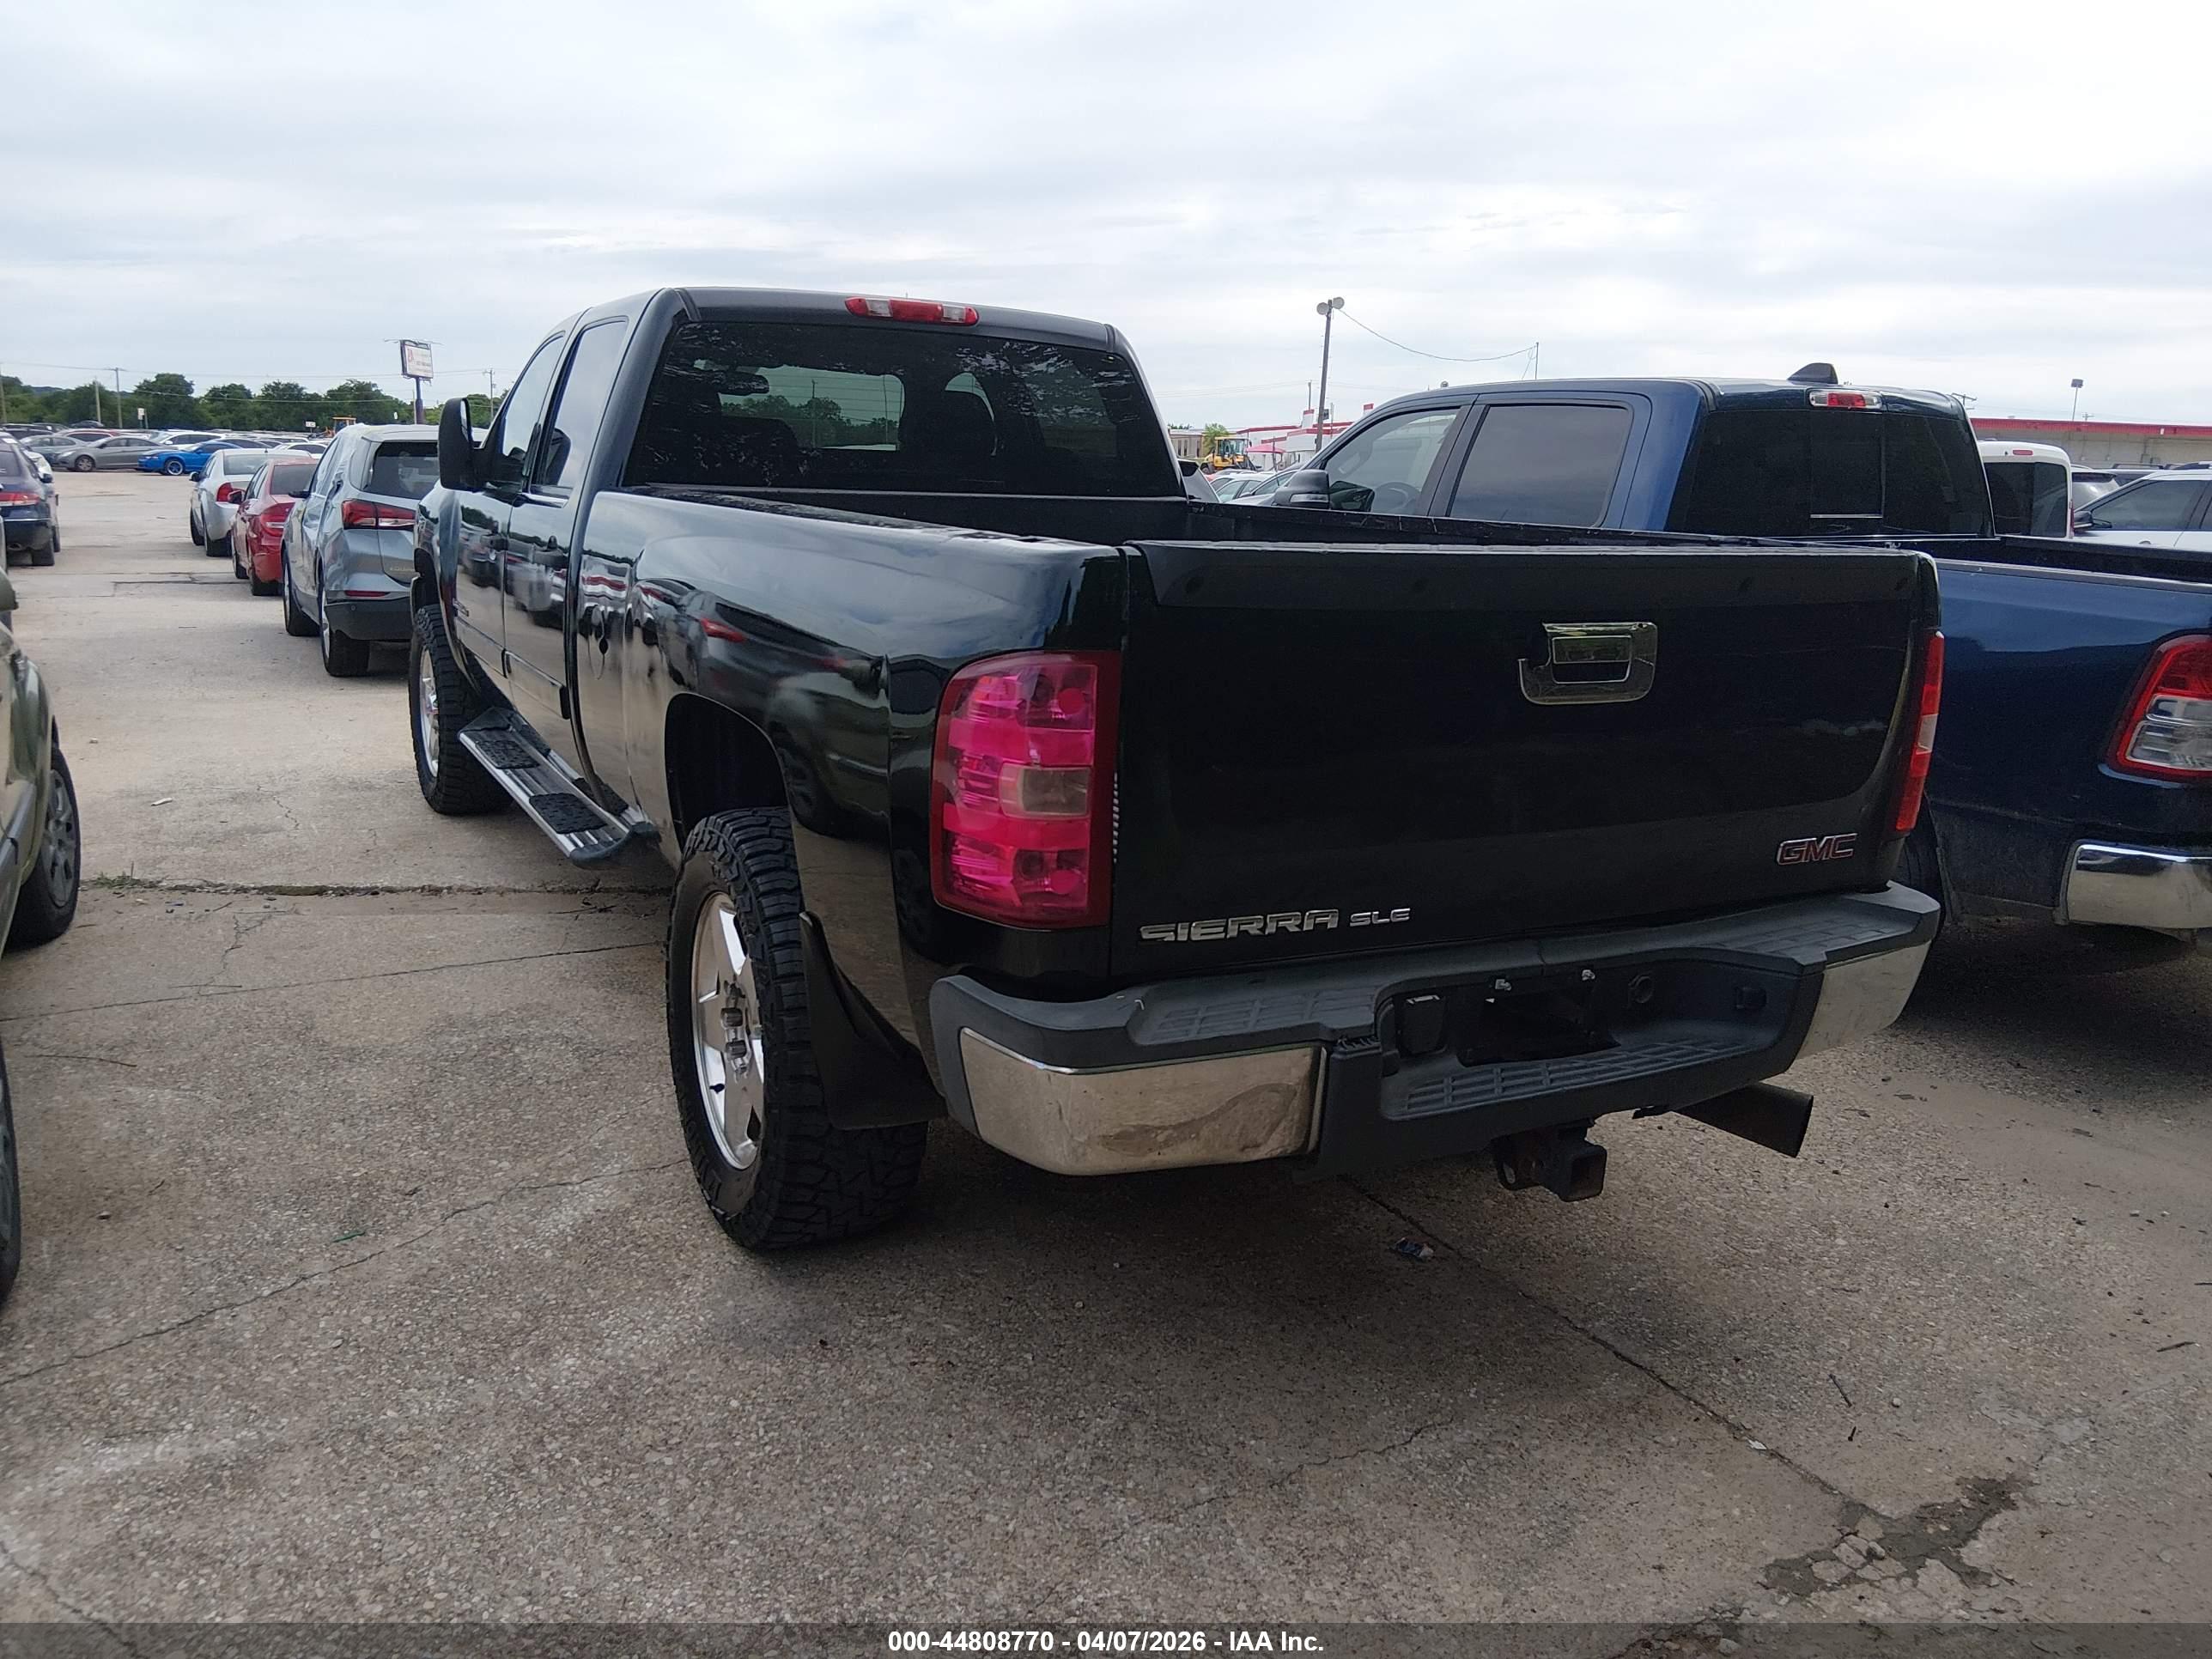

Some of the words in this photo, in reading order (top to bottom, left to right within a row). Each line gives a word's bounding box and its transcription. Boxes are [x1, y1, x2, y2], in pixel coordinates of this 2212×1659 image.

[1776, 832, 1858, 866] GMC
[1139, 908, 1340, 942] SIERRA
[1349, 907, 1411, 927] SLE
